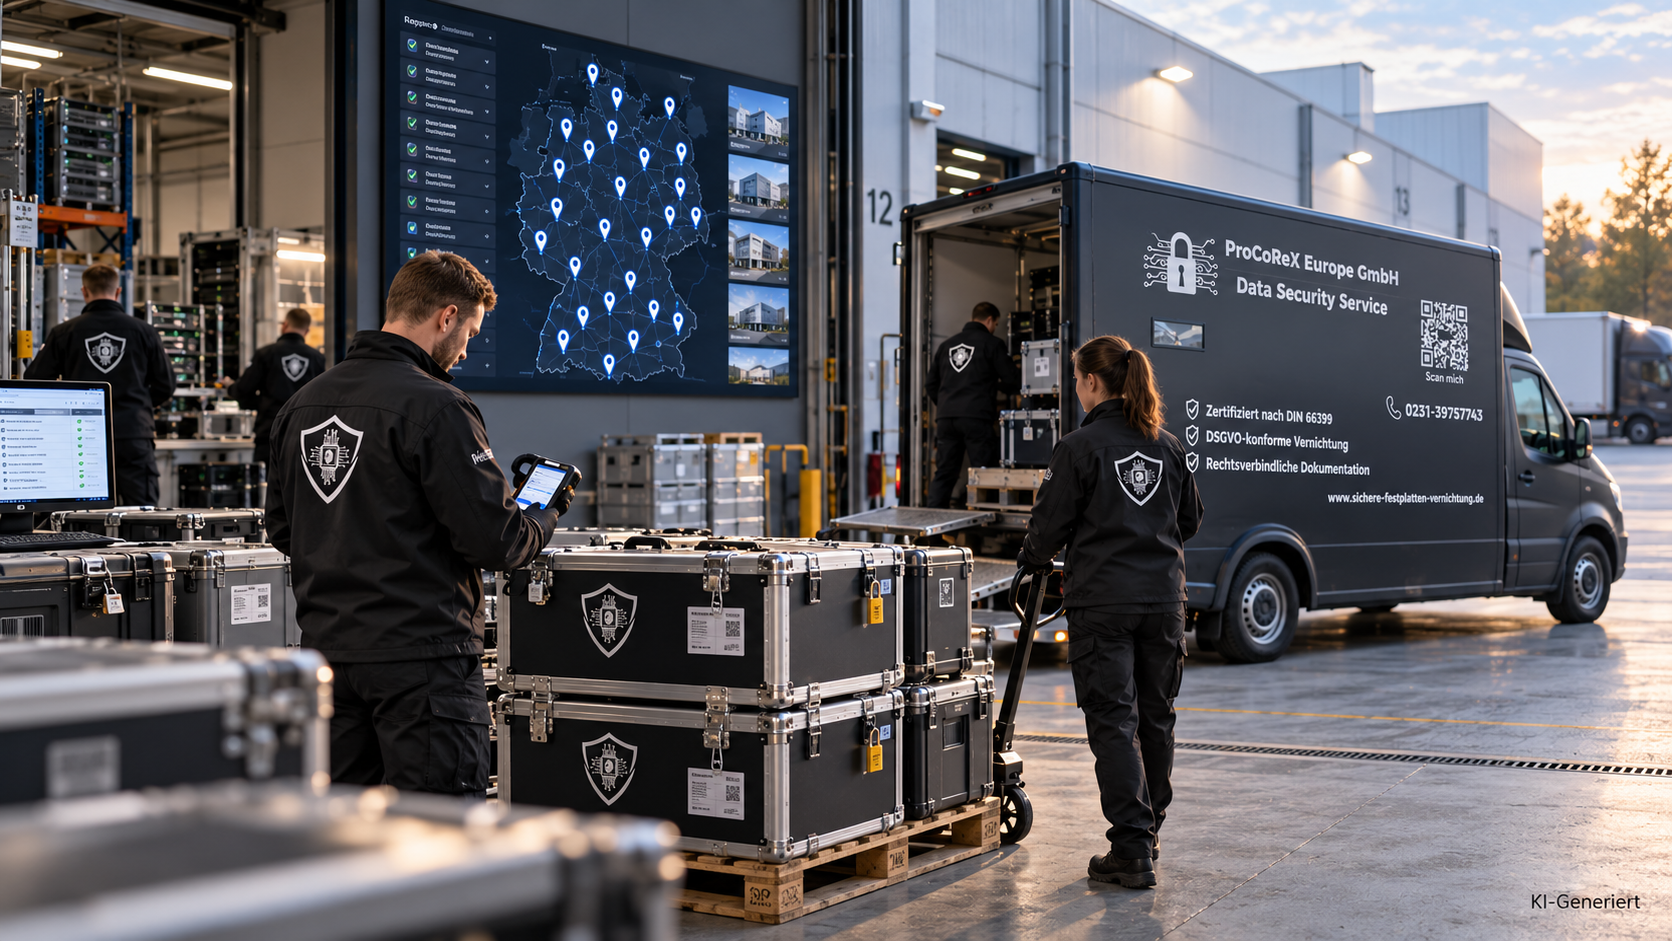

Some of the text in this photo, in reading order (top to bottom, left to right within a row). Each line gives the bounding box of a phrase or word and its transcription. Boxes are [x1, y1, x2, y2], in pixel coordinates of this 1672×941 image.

[867, 188, 893, 226] 12
[1395, 187, 1410, 216] 13
[1226, 239, 1398, 285] ProCoReX Europe GmbH
[1237, 277, 1387, 315] Data Security Service
[1426, 372, 1464, 384] Scan mich
[1206, 405, 1332, 424] Zertifiziert nach DIN 66399
[1406, 403, 1482, 421] 0231-39757743
[1207, 430, 1348, 453] DSGVO-konforme Vernichtung
[1207, 457, 1369, 475] Rechtsverbindliche Dokumentation
[1328, 492, 1484, 505] www.sichere-festplatten-vernichtung.de
